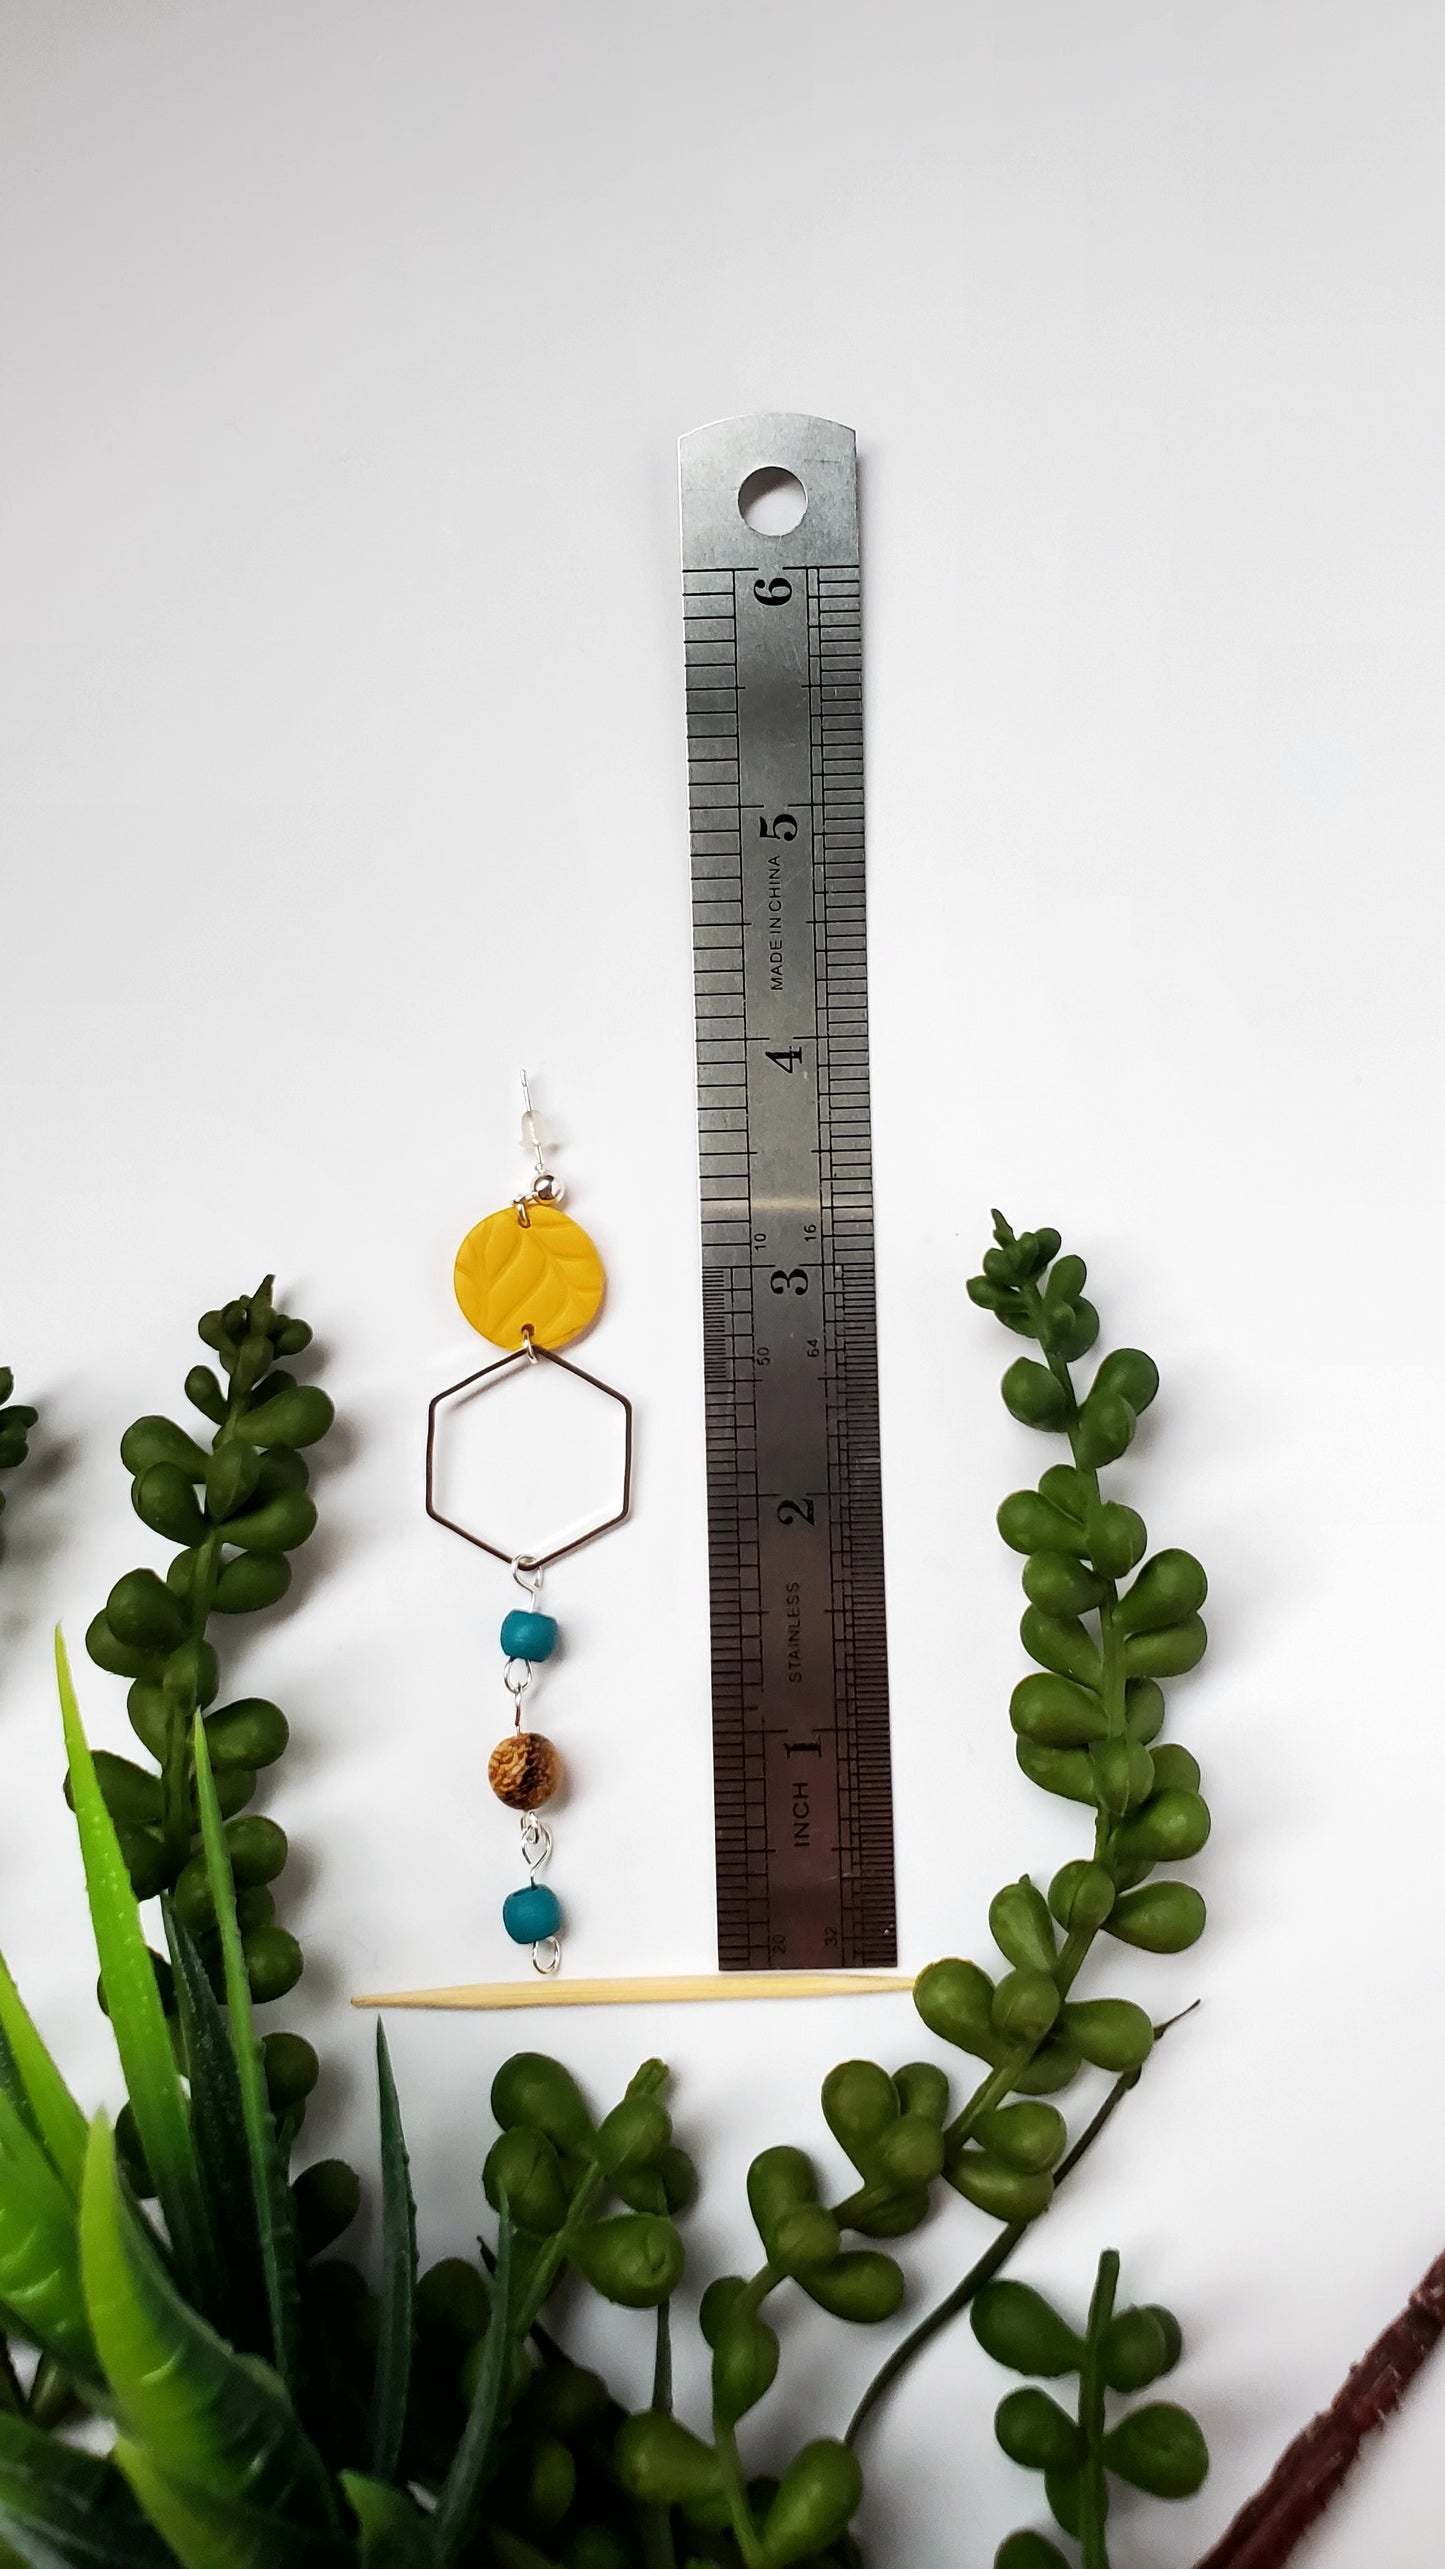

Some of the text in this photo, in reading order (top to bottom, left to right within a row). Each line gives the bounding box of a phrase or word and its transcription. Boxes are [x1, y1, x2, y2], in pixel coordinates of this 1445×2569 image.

[753, 577, 793, 607] 6
[759, 813, 798, 842] 5
[767, 854, 784, 991] MADE IN CHINA
[765, 1045, 802, 1074] 4
[753, 1232, 767, 1251] 10
[803, 1223, 817, 1242] 16
[770, 1268, 809, 1296] 3
[756, 1346, 771, 1366] 50
[807, 1338, 820, 1358] 64
[777, 1498, 815, 1526] 2
[786, 1581, 802, 1683] STAINLESS
[784, 1735, 822, 1759] 1
[792, 1782, 810, 1848] INCH
[824, 1926, 838, 1946] 32
